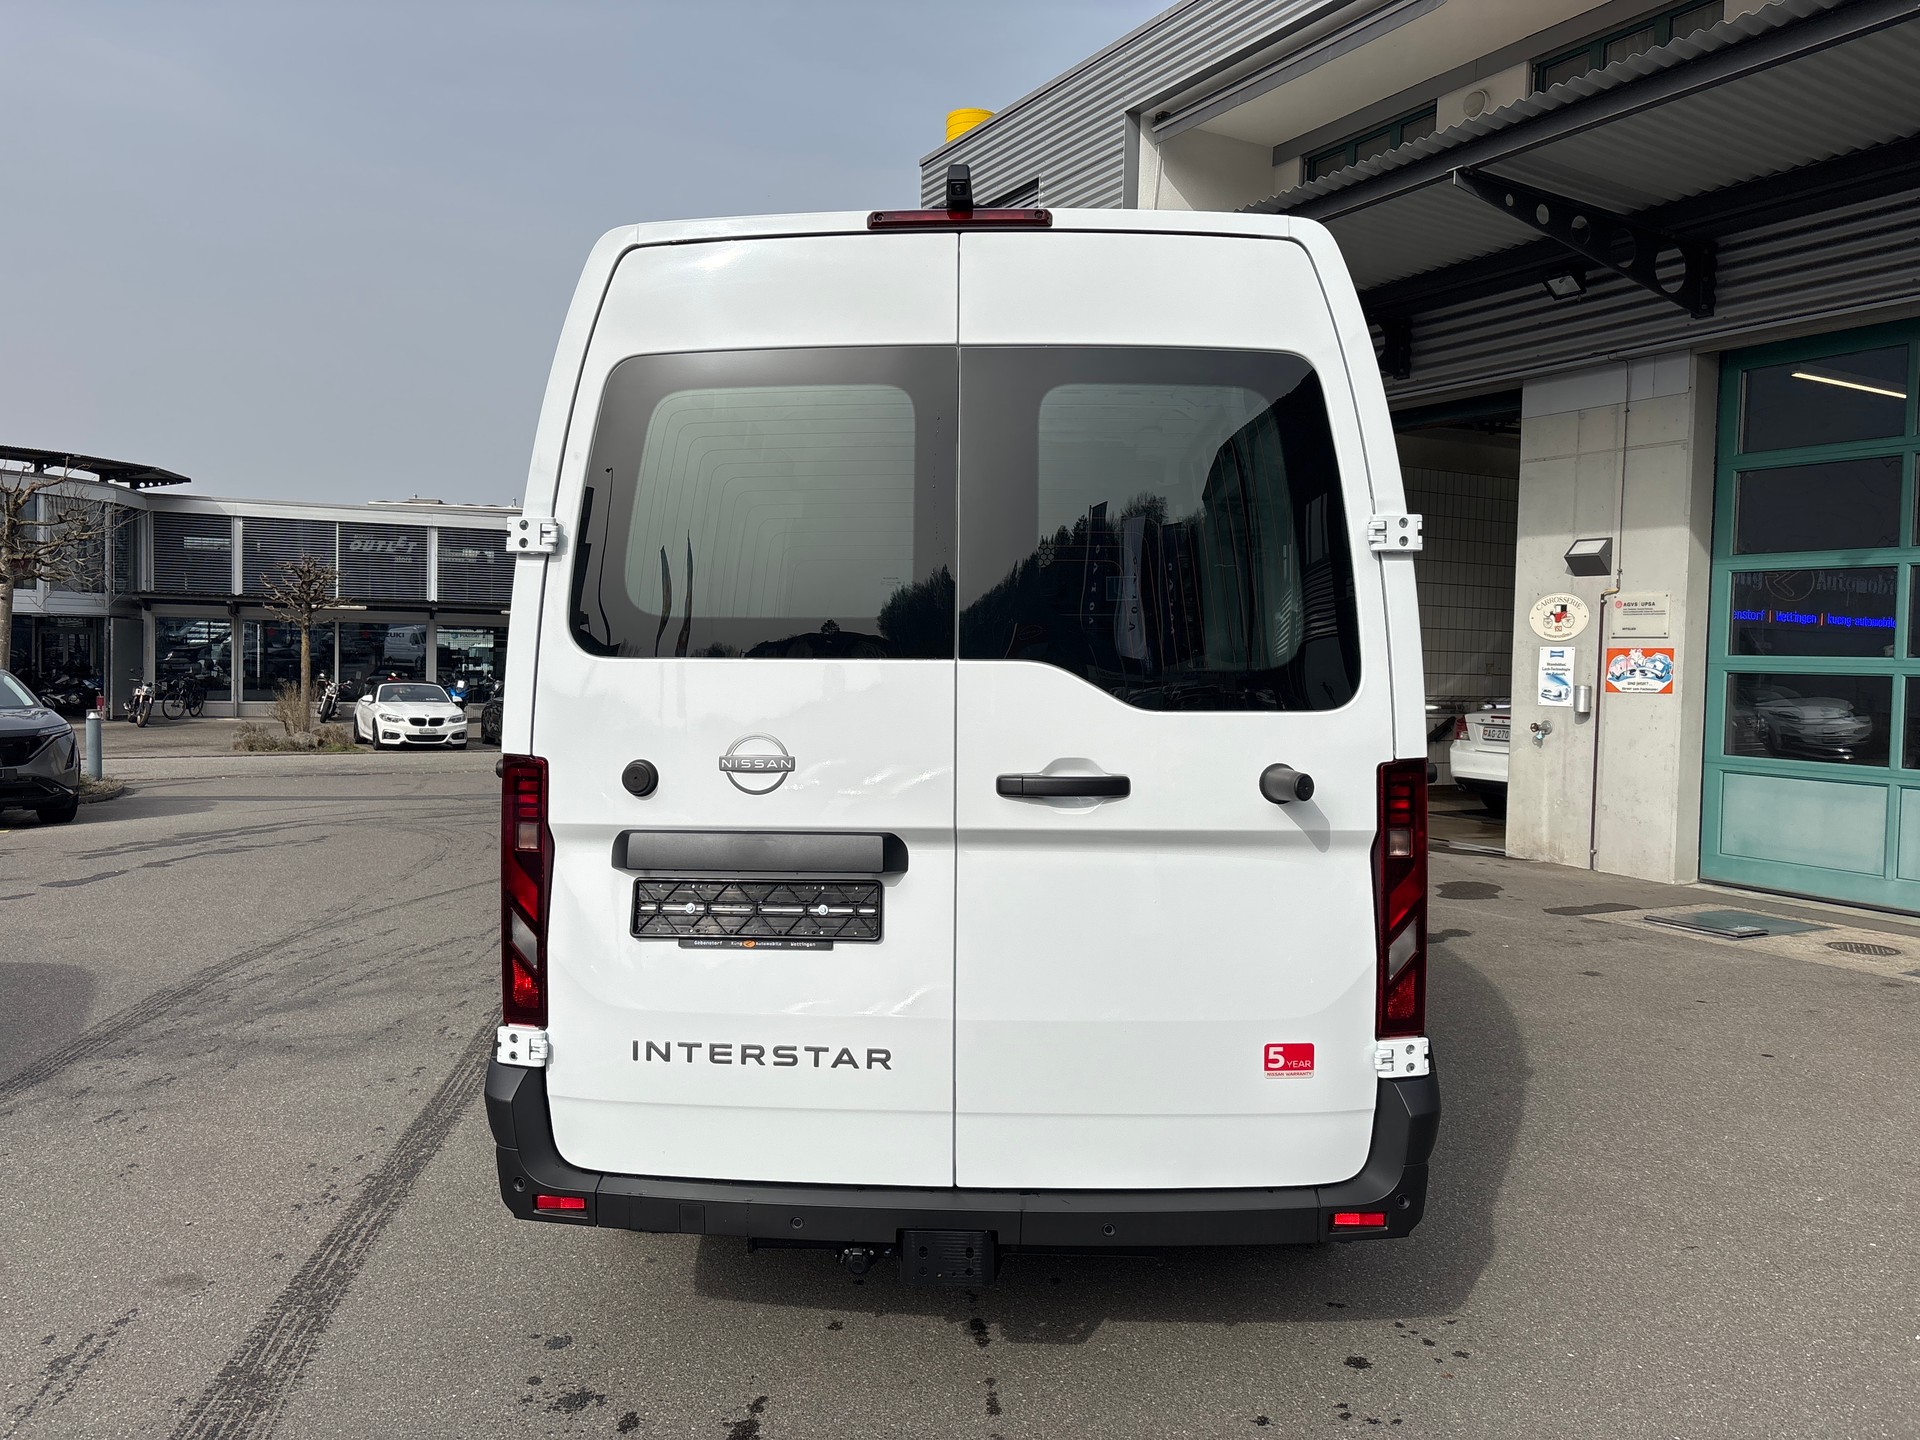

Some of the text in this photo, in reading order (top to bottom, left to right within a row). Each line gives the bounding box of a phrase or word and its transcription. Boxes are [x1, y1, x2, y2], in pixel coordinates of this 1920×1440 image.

[350, 536, 419, 552] OUTLET
[1536, 596, 1583, 611] CARROSSERIE
[1775, 611, 1817, 624] Wettingen
[721, 759, 792, 769] NISSAN
[632, 1039, 892, 1070] INTERSTAR
[1267, 1046, 1312, 1069] 5 YEAR
